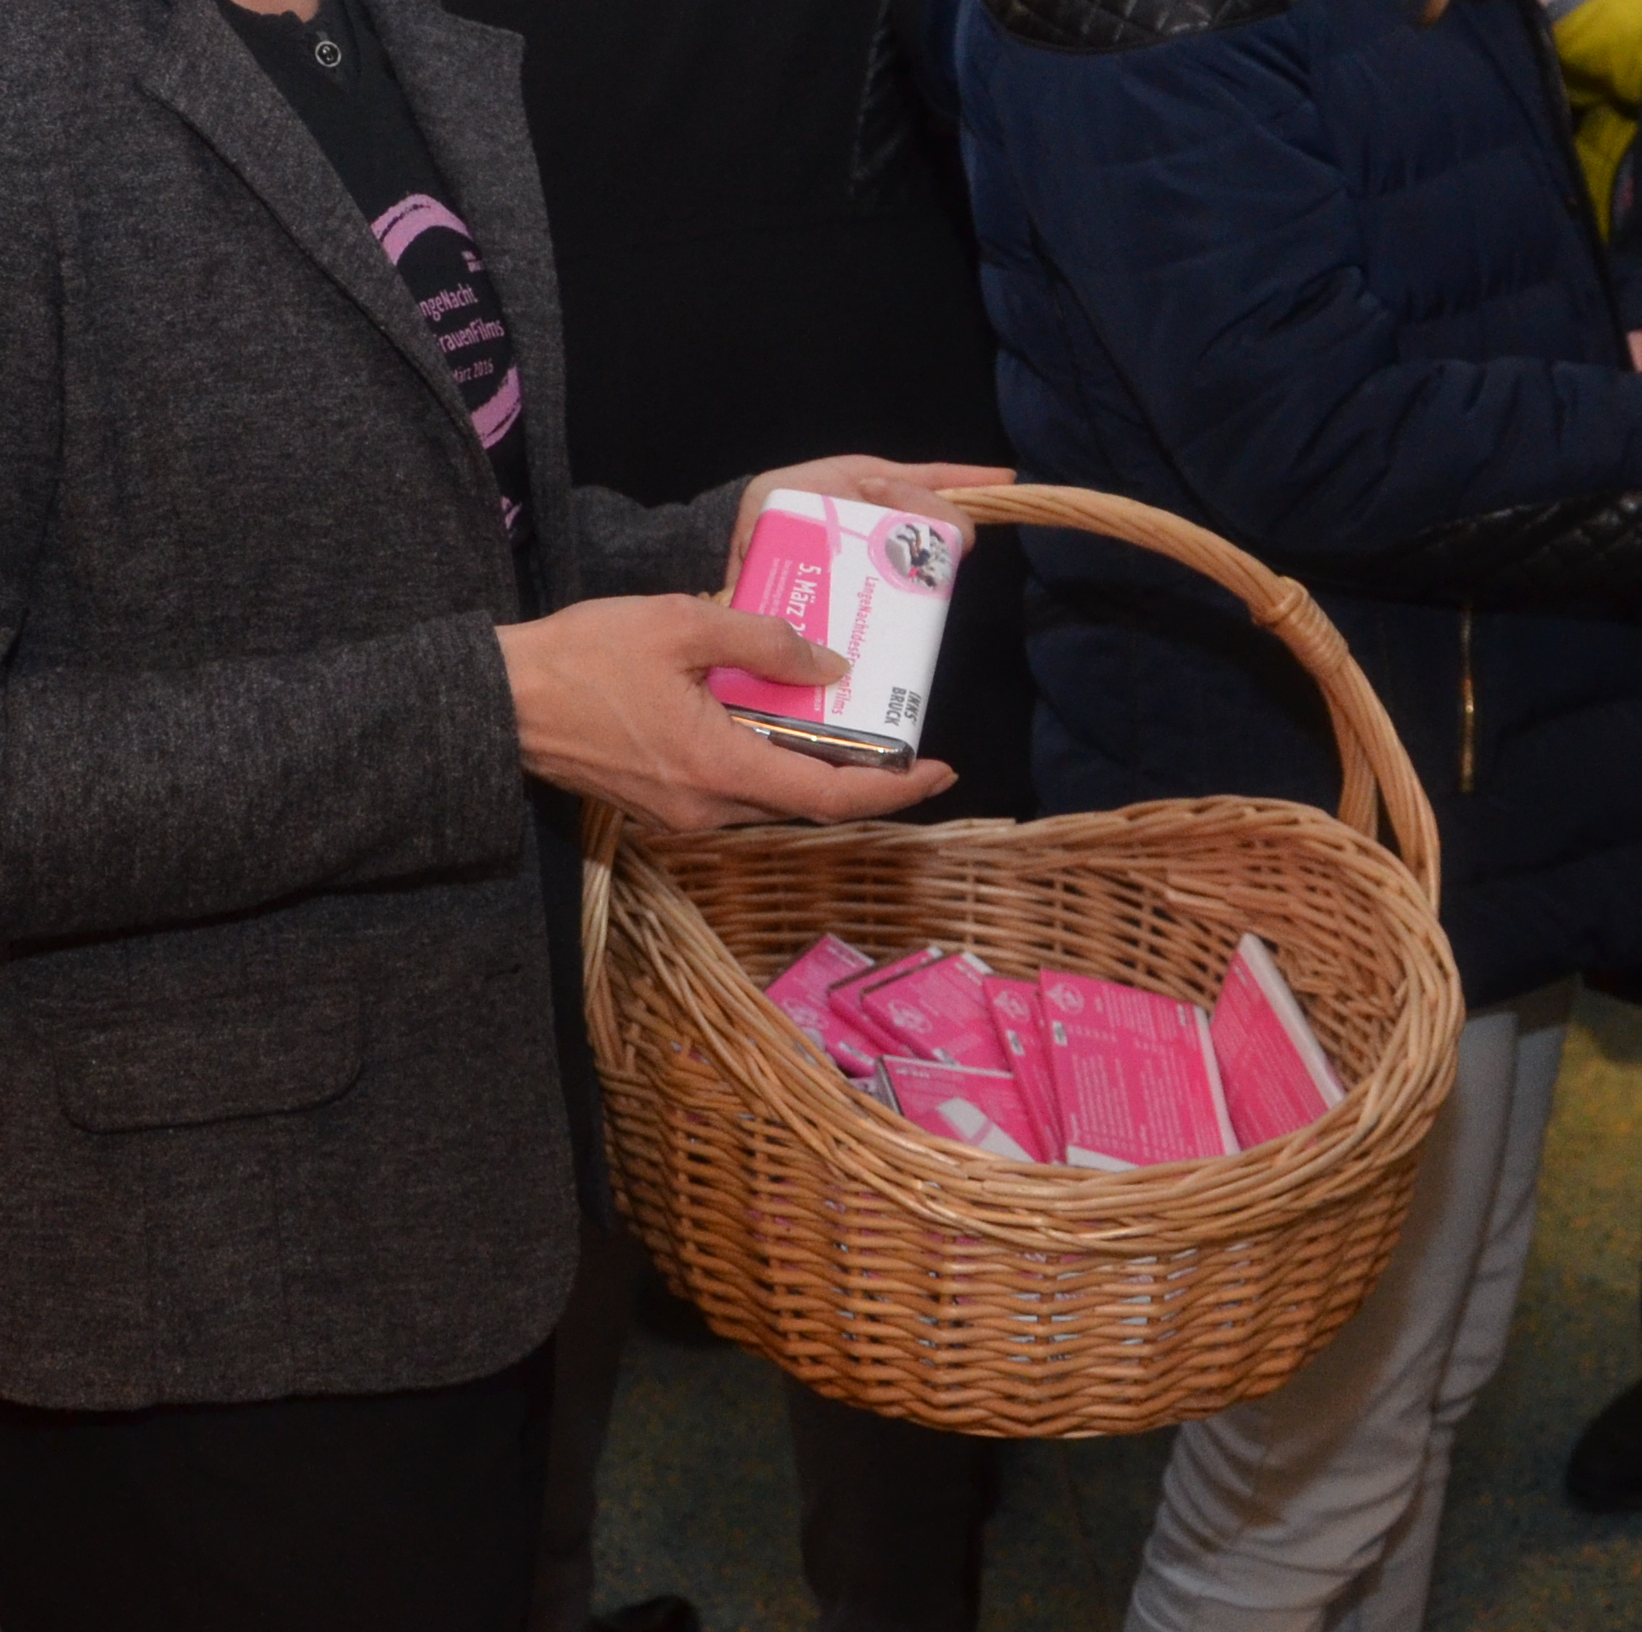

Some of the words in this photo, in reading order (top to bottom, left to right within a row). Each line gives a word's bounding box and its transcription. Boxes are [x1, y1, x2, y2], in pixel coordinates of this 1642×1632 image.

[796, 562, 822, 581] 5.
[786, 577, 818, 620] März
[830, 575, 880, 716] LangeNachtdesFrenFilms
[884, 686, 907, 726] BRUCK
